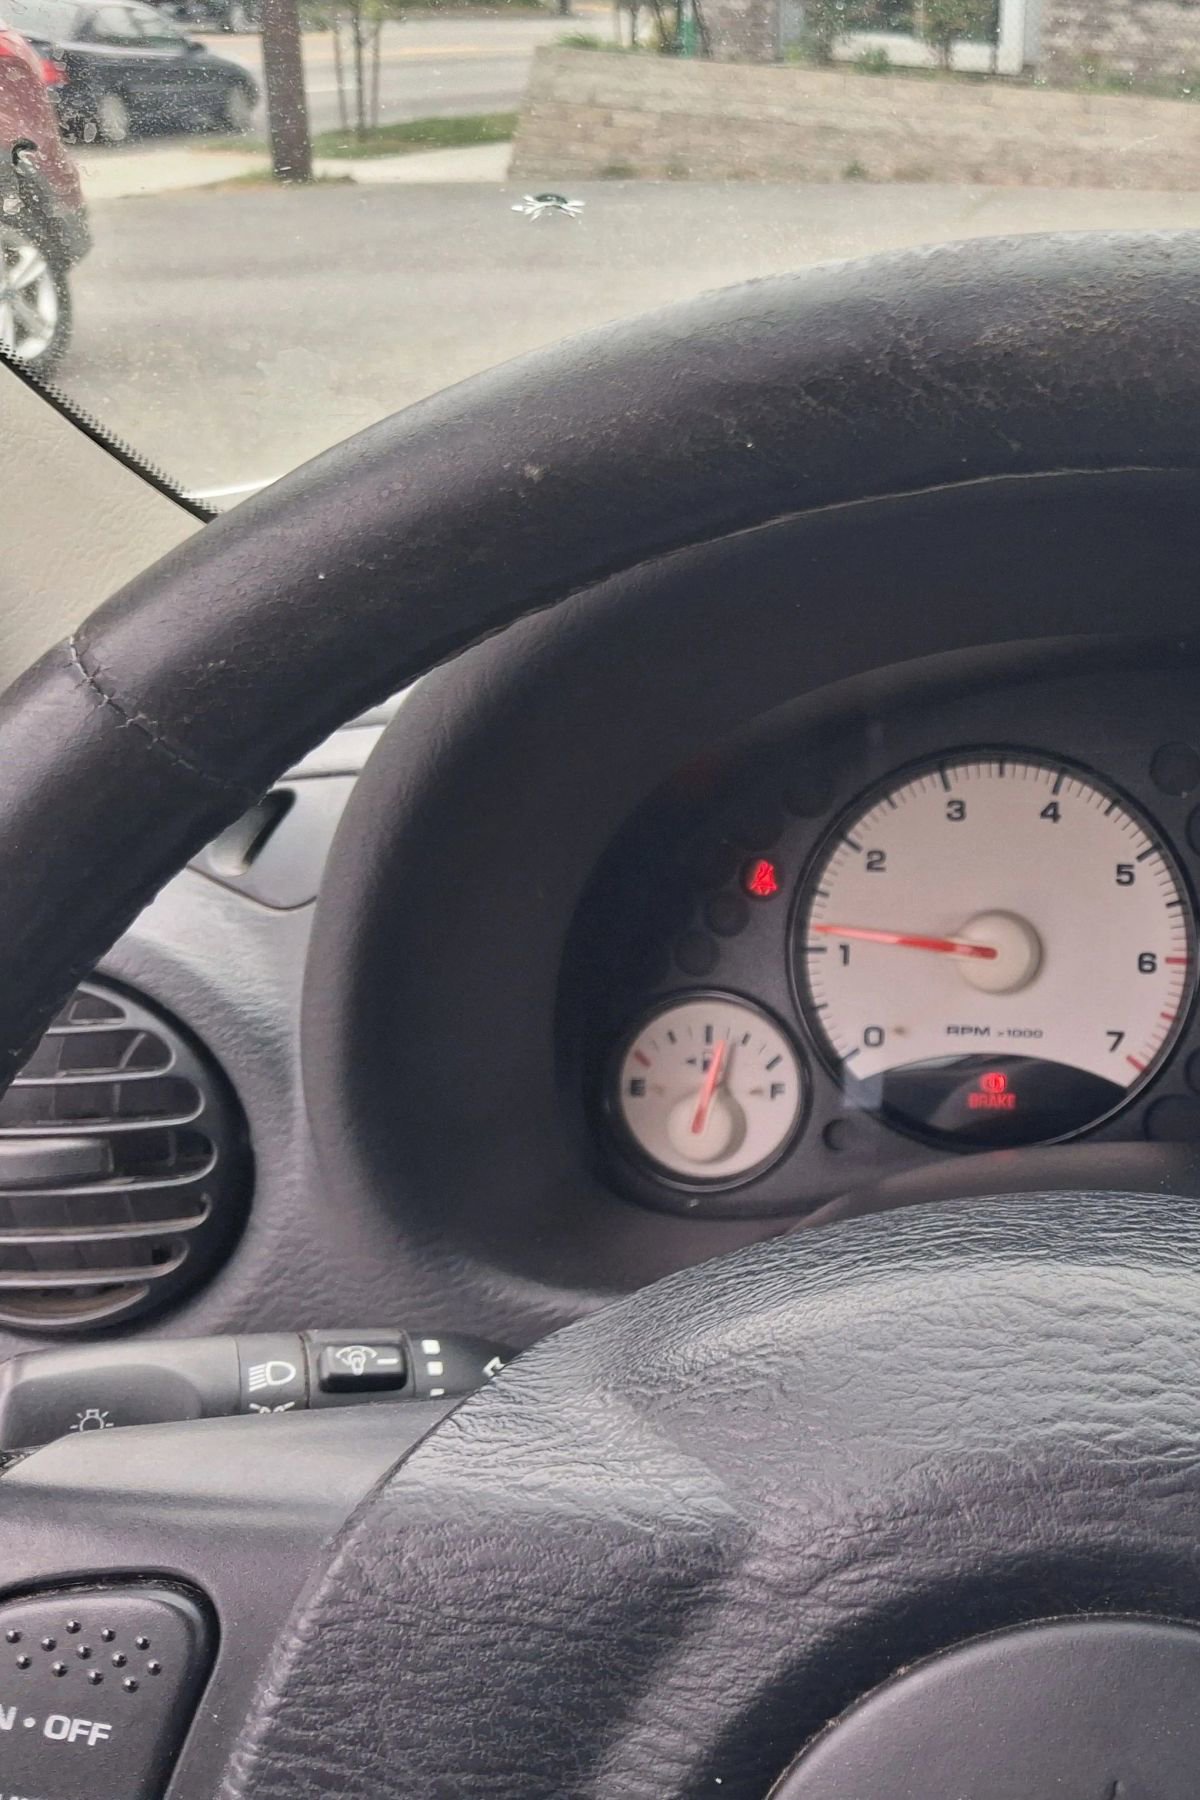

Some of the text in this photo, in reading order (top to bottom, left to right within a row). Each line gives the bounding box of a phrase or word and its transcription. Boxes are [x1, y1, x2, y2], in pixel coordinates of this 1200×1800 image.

[946, 800, 967, 823] 3
[1040, 801, 1062, 823] 4
[866, 850, 886, 872] 2
[1116, 864, 1135, 886] 5
[839, 944, 851, 966] 1
[1138, 952, 1157, 975] 6
[864, 1026, 885, 1048] 0
[946, 1025, 991, 1038] RPM
[1106, 1030, 1125, 1053] 7
[43, 1715, 112, 1746] OFF
